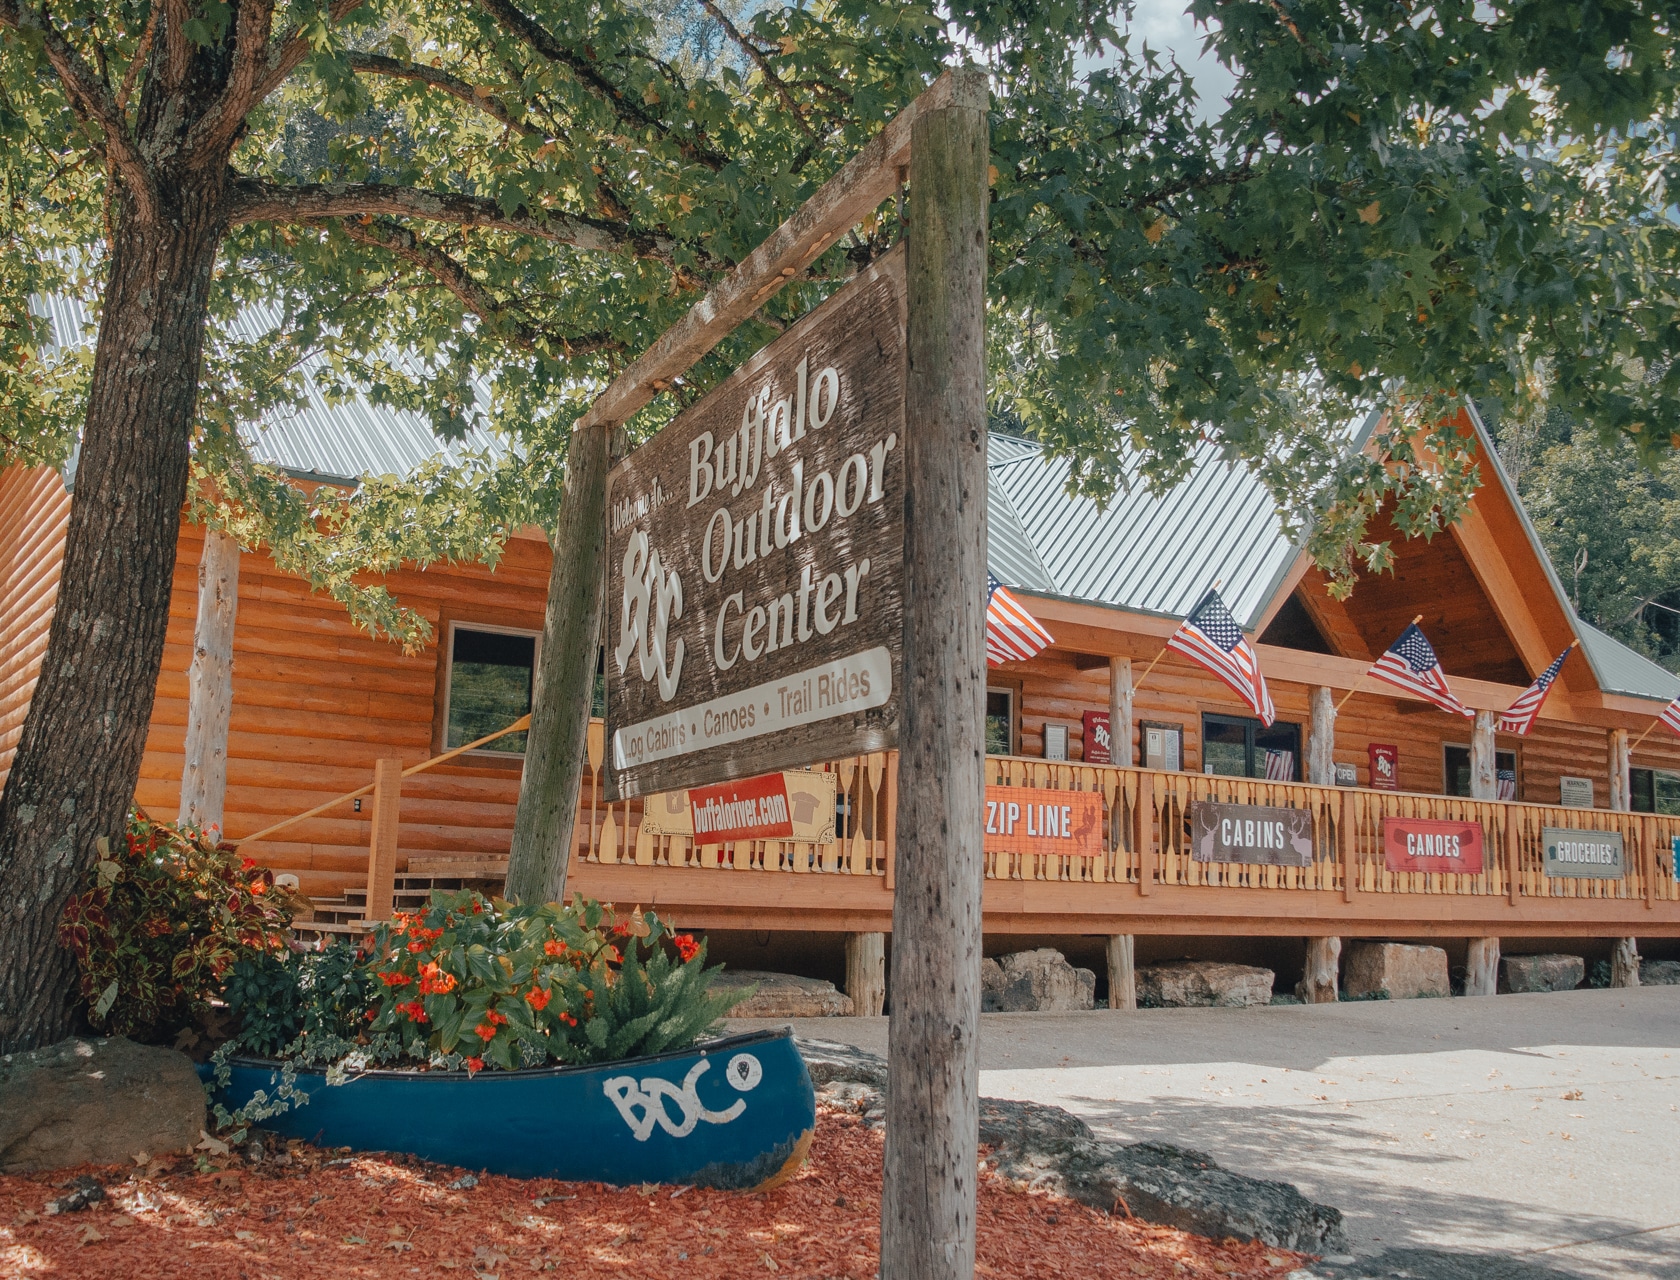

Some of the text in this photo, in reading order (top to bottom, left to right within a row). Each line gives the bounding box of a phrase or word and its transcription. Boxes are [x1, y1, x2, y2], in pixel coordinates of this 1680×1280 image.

[686, 355, 839, 509] Buffalo
[613, 493, 651, 534] Welcome
[703, 433, 897, 583] Outdoor
[714, 558, 871, 671] Center
[625, 667, 870, 762] Log Cabins Canoes Trail Rides
[1337, 768, 1357, 781] OPEN
[1377, 755, 1392, 777] BOC
[692, 793, 789, 834] buffaloriver.com
[986, 801, 1071, 838] ZIP LINE
[1221, 818, 1284, 850] CABINS
[1407, 833, 1460, 857] CANOES
[1557, 841, 1612, 865] GROCERIES
[603, 1059, 747, 1142] BOC
